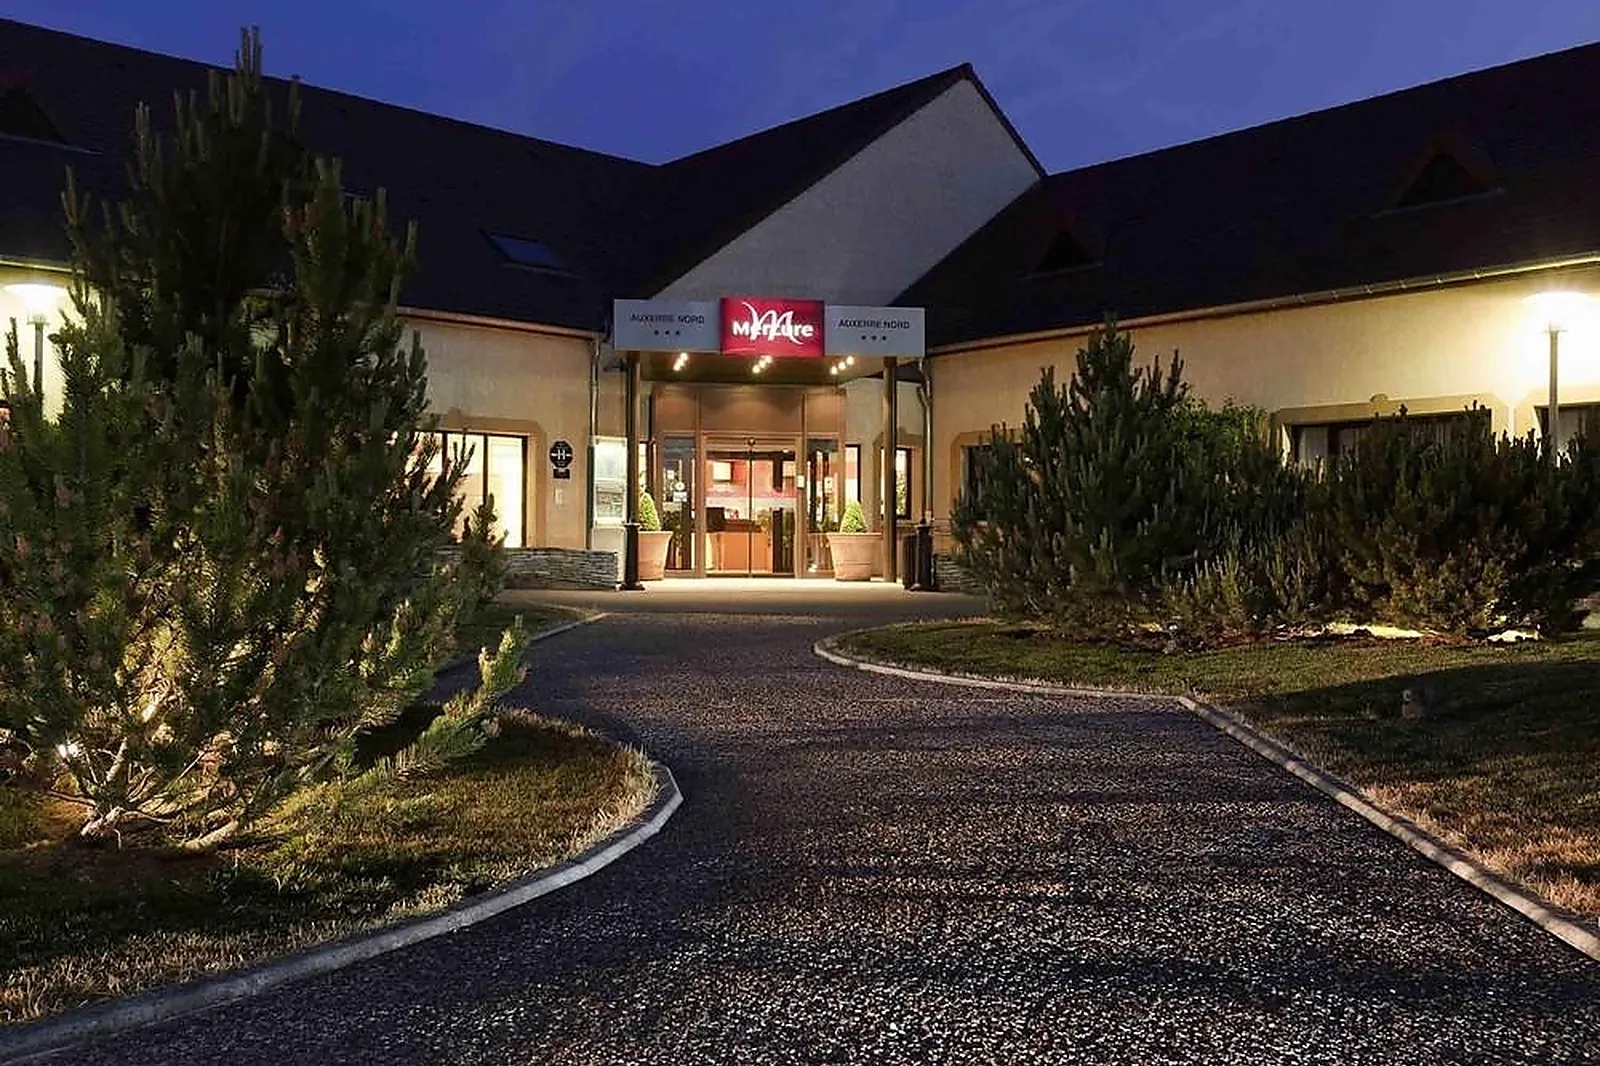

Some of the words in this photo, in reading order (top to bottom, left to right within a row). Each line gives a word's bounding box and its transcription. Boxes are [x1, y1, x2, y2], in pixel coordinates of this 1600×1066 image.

[677, 313, 705, 324] NORD
[732, 320, 814, 337] Mercure
[883, 319, 911, 330] NORD
